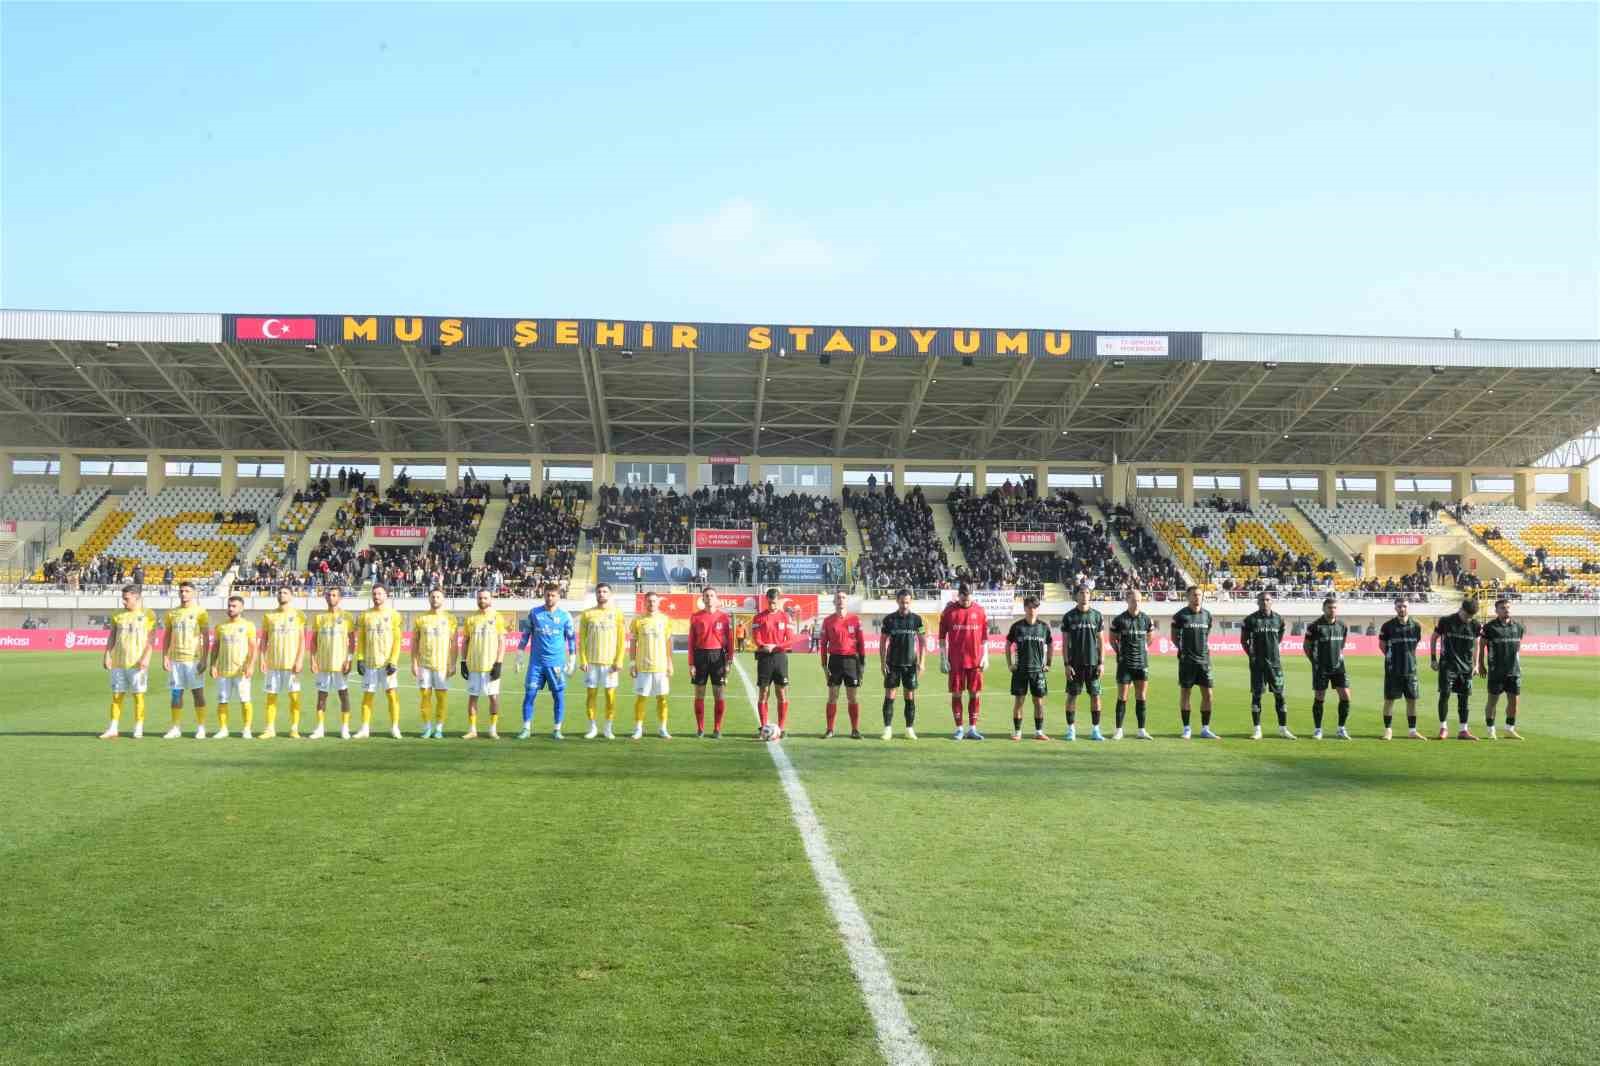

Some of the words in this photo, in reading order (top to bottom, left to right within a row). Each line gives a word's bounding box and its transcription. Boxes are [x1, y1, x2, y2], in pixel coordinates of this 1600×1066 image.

[342, 317, 465, 346] MUŞ
[513, 320, 699, 350] ŞEHİR
[747, 326, 1073, 355] STADYUMU
[0, 632, 30, 646] nkası
[76, 632, 108, 646] Ziraa
